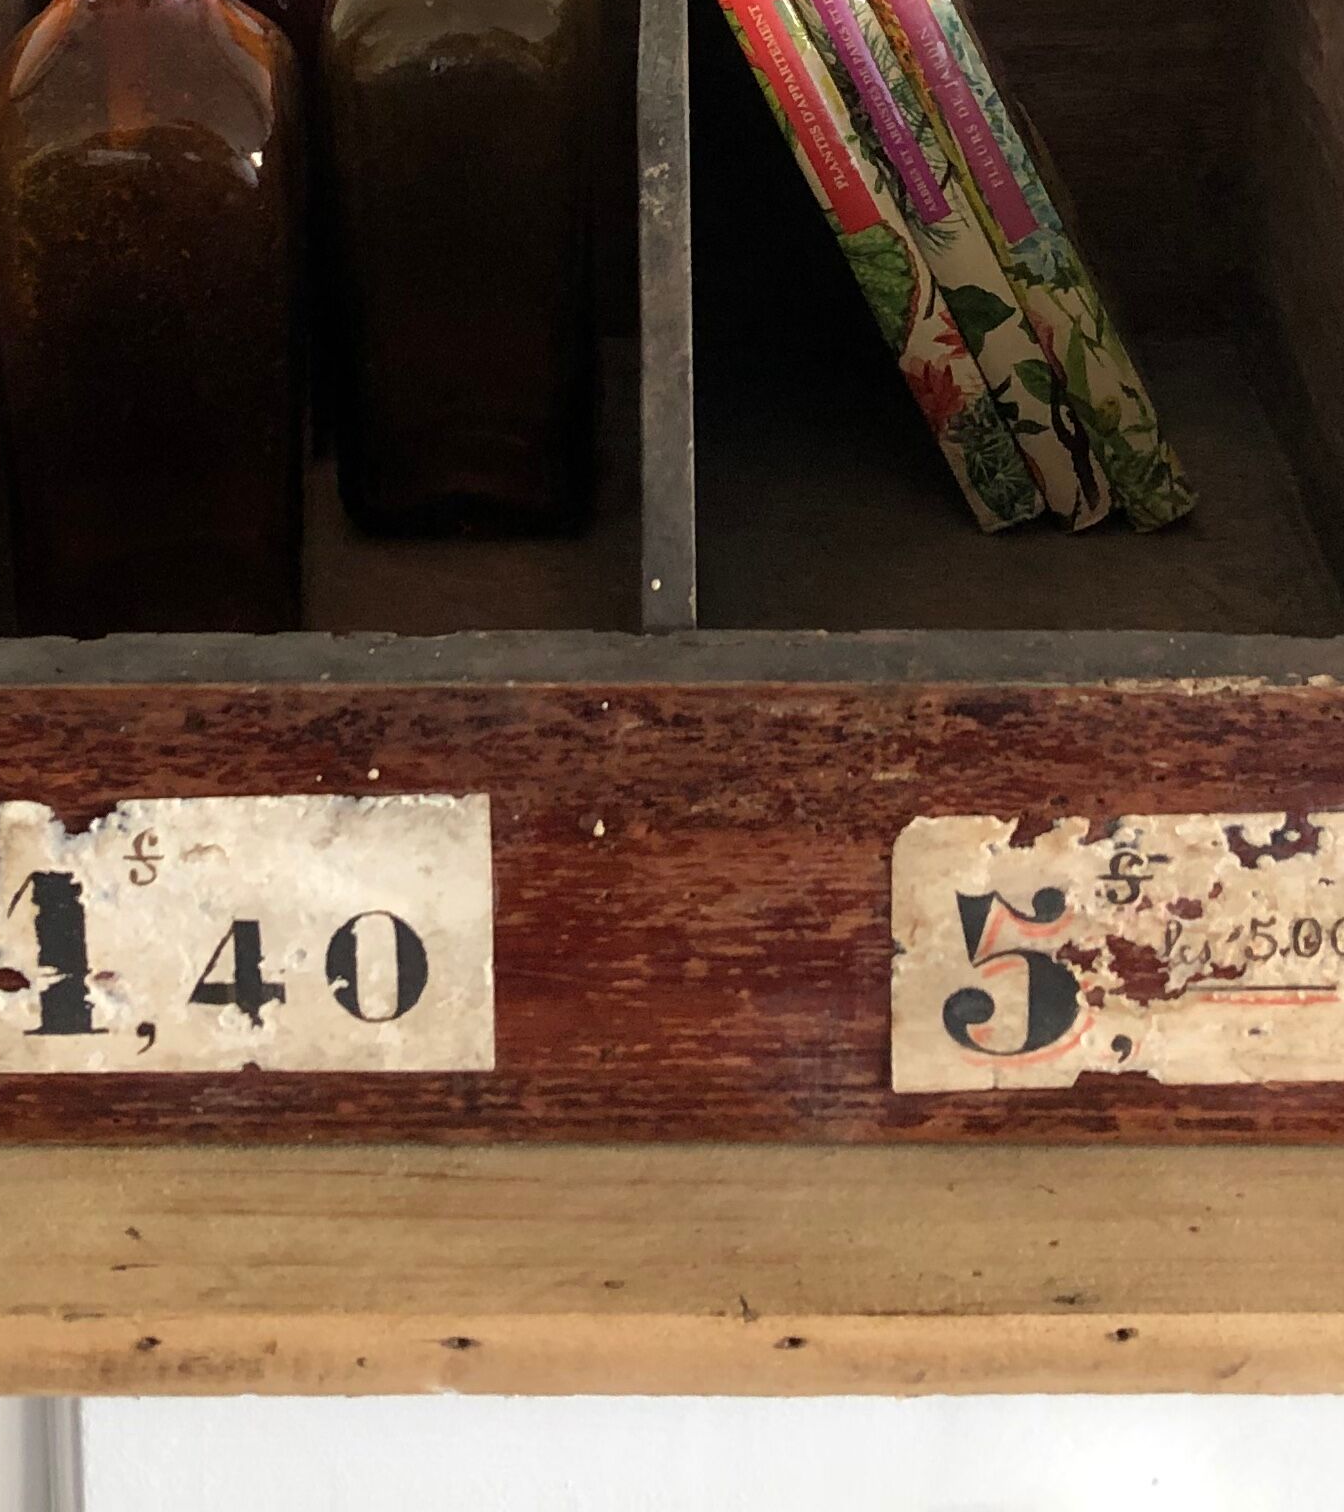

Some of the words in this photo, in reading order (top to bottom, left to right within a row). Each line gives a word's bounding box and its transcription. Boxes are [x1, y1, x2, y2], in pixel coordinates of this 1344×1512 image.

[746, 1, 816, 124] D'APPARTEMENT
[836, 24, 865, 65] PARCS
[917, 23, 960, 91] JARDIN
[856, 65, 874, 85] DE
[950, 93, 971, 119] DE
[807, 123, 851, 191] PLANTES
[897, 146, 915, 167] ET
[964, 122, 1005, 188] FLEURS
